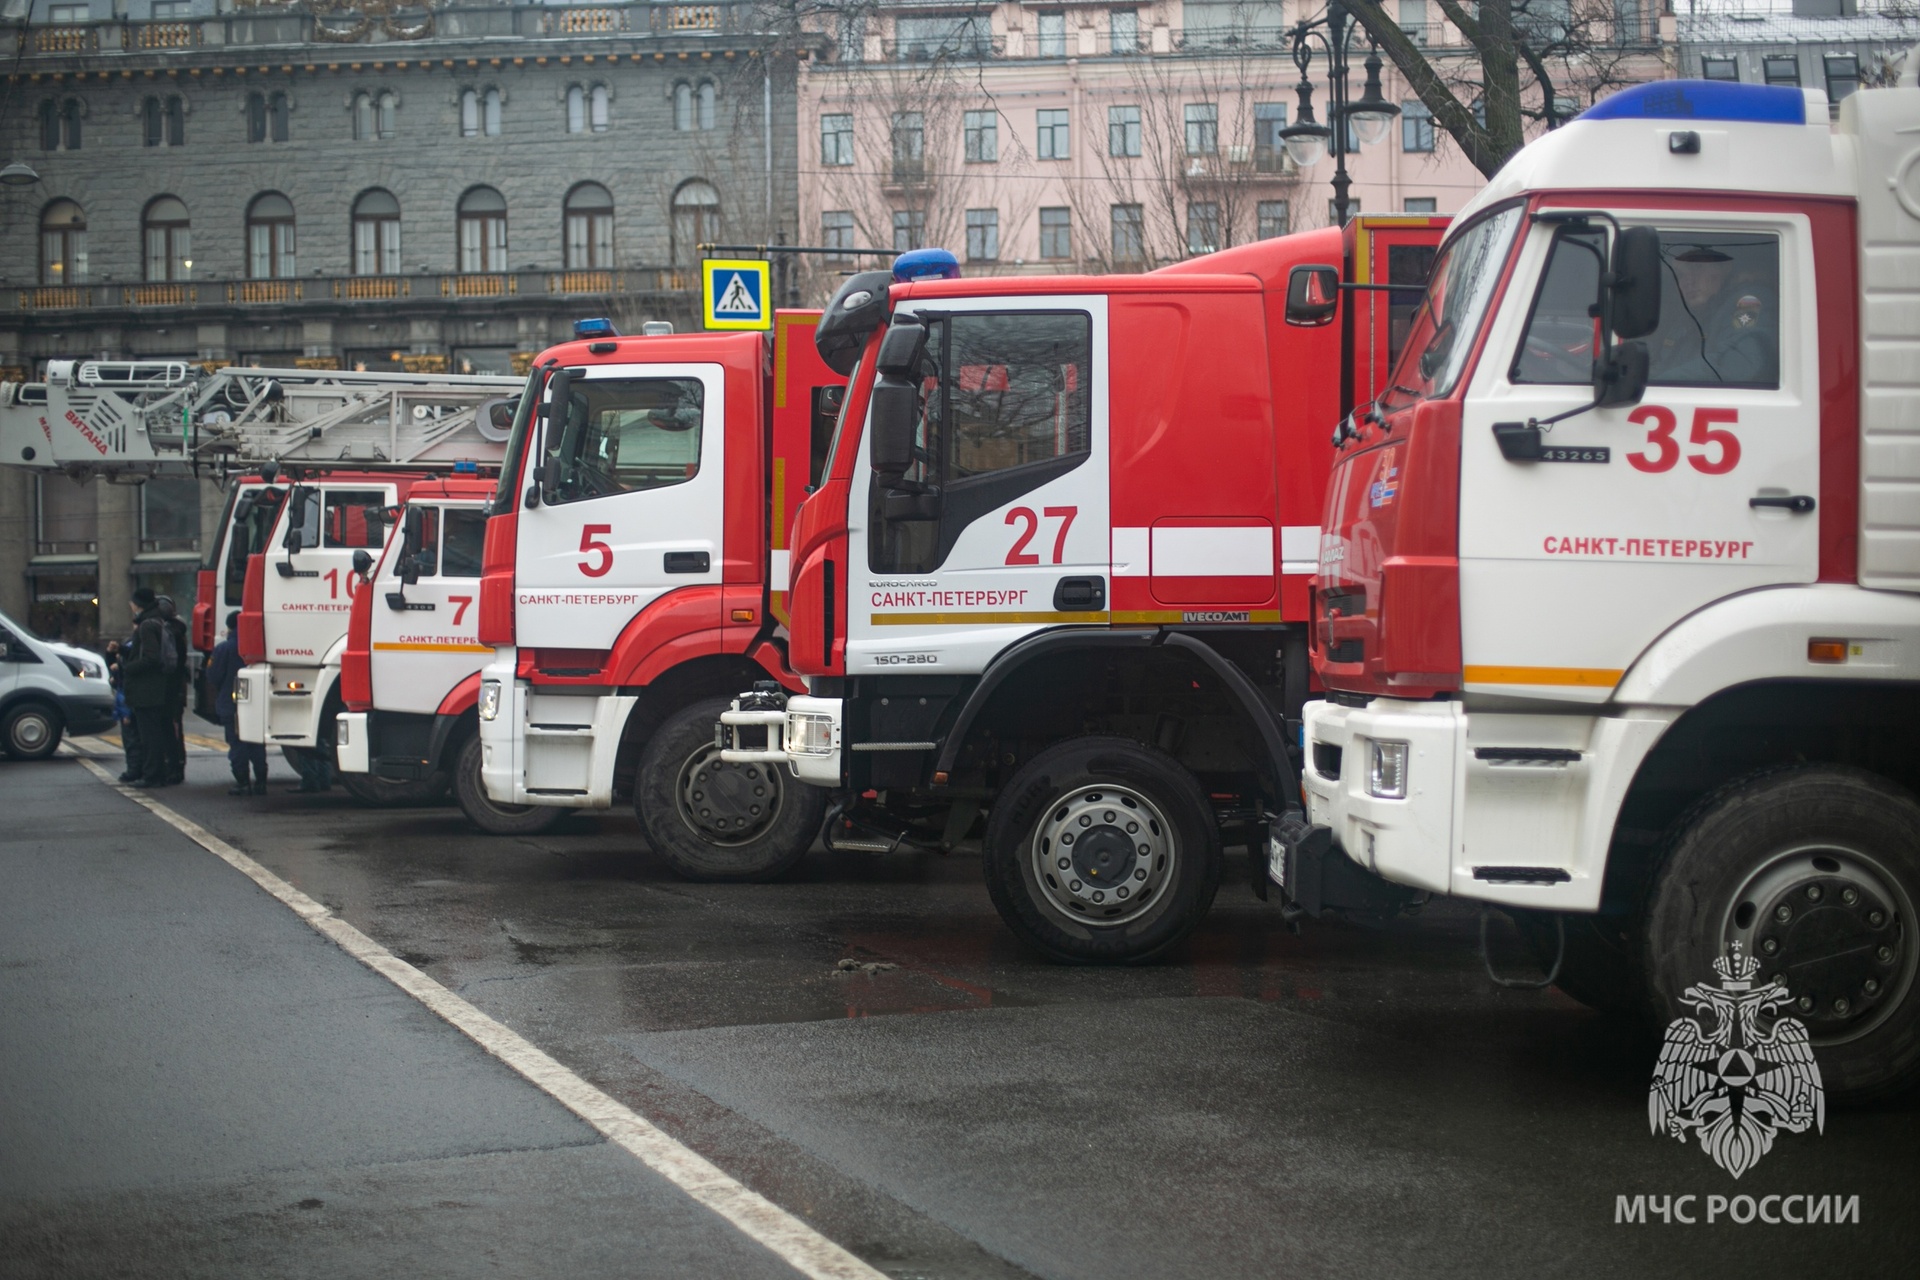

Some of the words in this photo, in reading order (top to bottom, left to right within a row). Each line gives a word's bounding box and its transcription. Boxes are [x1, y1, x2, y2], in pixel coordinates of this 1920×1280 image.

[64, 410, 108, 455] ВИТАНД
[1625, 405, 1742, 475] 35
[1543, 450, 1607, 461] 43265
[1004, 505, 1078, 565] 27
[577, 524, 614, 577] 5
[1543, 536, 1754, 558] САНКТ-ПЕТЕРБУРГ
[869, 580, 938, 588] EUROCARGO
[519, 594, 639, 605] САНКТ-ПЕТЕРБУРГ
[871, 590, 1028, 607] САНКТ-ПЕТЕРБУРГ
[447, 595, 472, 626] 7
[1183, 612, 1223, 622] IVECO
[873, 655, 938, 666] 150-280
